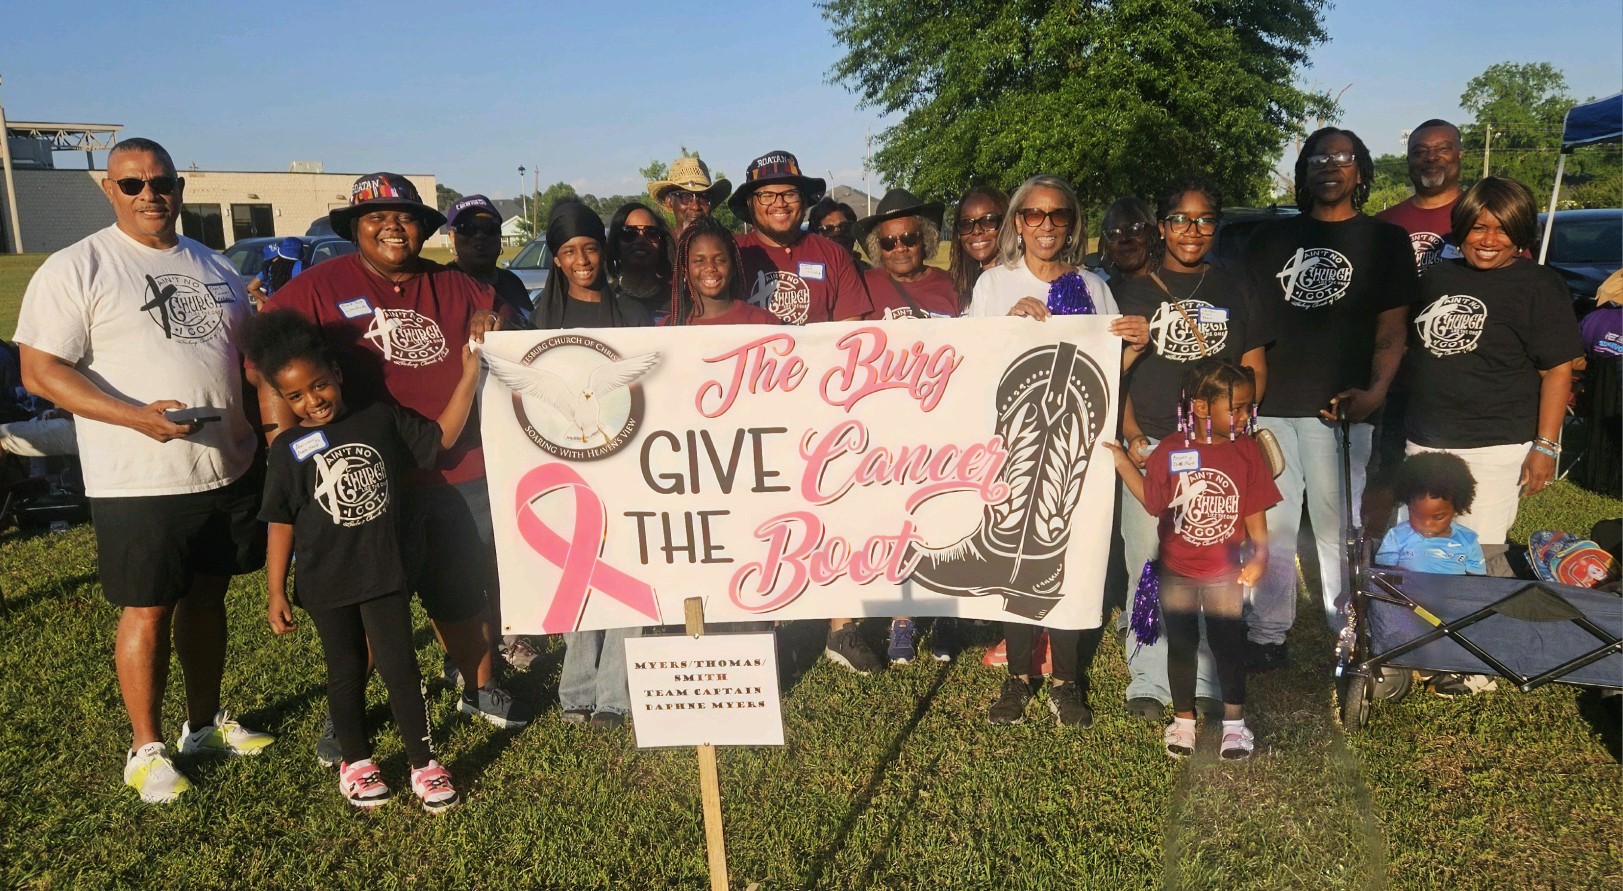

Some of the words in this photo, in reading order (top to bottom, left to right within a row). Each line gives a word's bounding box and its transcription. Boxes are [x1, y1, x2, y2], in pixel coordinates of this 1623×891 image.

[1428, 235, 1440, 245] NO
[1304, 250, 1329, 259] AIN'T
[1329, 253, 1343, 264] NO
[158, 276, 180, 287] AIN'T
[184, 278, 200, 288] NO
[765, 273, 786, 282] AIN'T
[786, 275, 799, 285] NO
[1299, 267, 1354, 289] CHURCH
[1305, 287, 1333, 300] GOT
[1444, 297, 1470, 305] AIN'T
[384, 311, 408, 319] AIN'T
[409, 313, 424, 323] NO
[1433, 313, 1487, 337] CHURCH
[391, 325, 444, 349] CHURCH
[1440, 339, 1466, 348] GOT
[523, 342, 548, 365] EESBURG
[548, 336, 582, 347] CHURCH
[694, 332, 809, 419] The
[818, 326, 965, 414] Burg
[524, 424, 557, 455] SOARING
[559, 447, 585, 460] WITH
[587, 437, 623, 459] HEAVEN'S
[621, 417, 637, 439] VIEW
[326, 447, 352, 466] AIN'T
[355, 447, 372, 458] NO
[639, 427, 791, 495] GIVE
[799, 419, 1012, 515] Cancer
[337, 462, 387, 503] CHURCH
[1189, 471, 1215, 483] AIN'T
[1215, 475, 1229, 489] NO
[355, 494, 382, 516] GOT
[1187, 495, 1240, 523] CHURCH
[1194, 524, 1223, 537] GOT
[623, 509, 735, 565] THE
[728, 510, 929, 614] Boot
[634, 658, 767, 670] MYERS/THOMAS/
[674, 673, 729, 682] SMITH
[643, 688, 689, 698] TEAM
[693, 686, 762, 697] CAPTAIN
[645, 701, 706, 711] DAPHNE
[711, 700, 766, 710] MYERS
